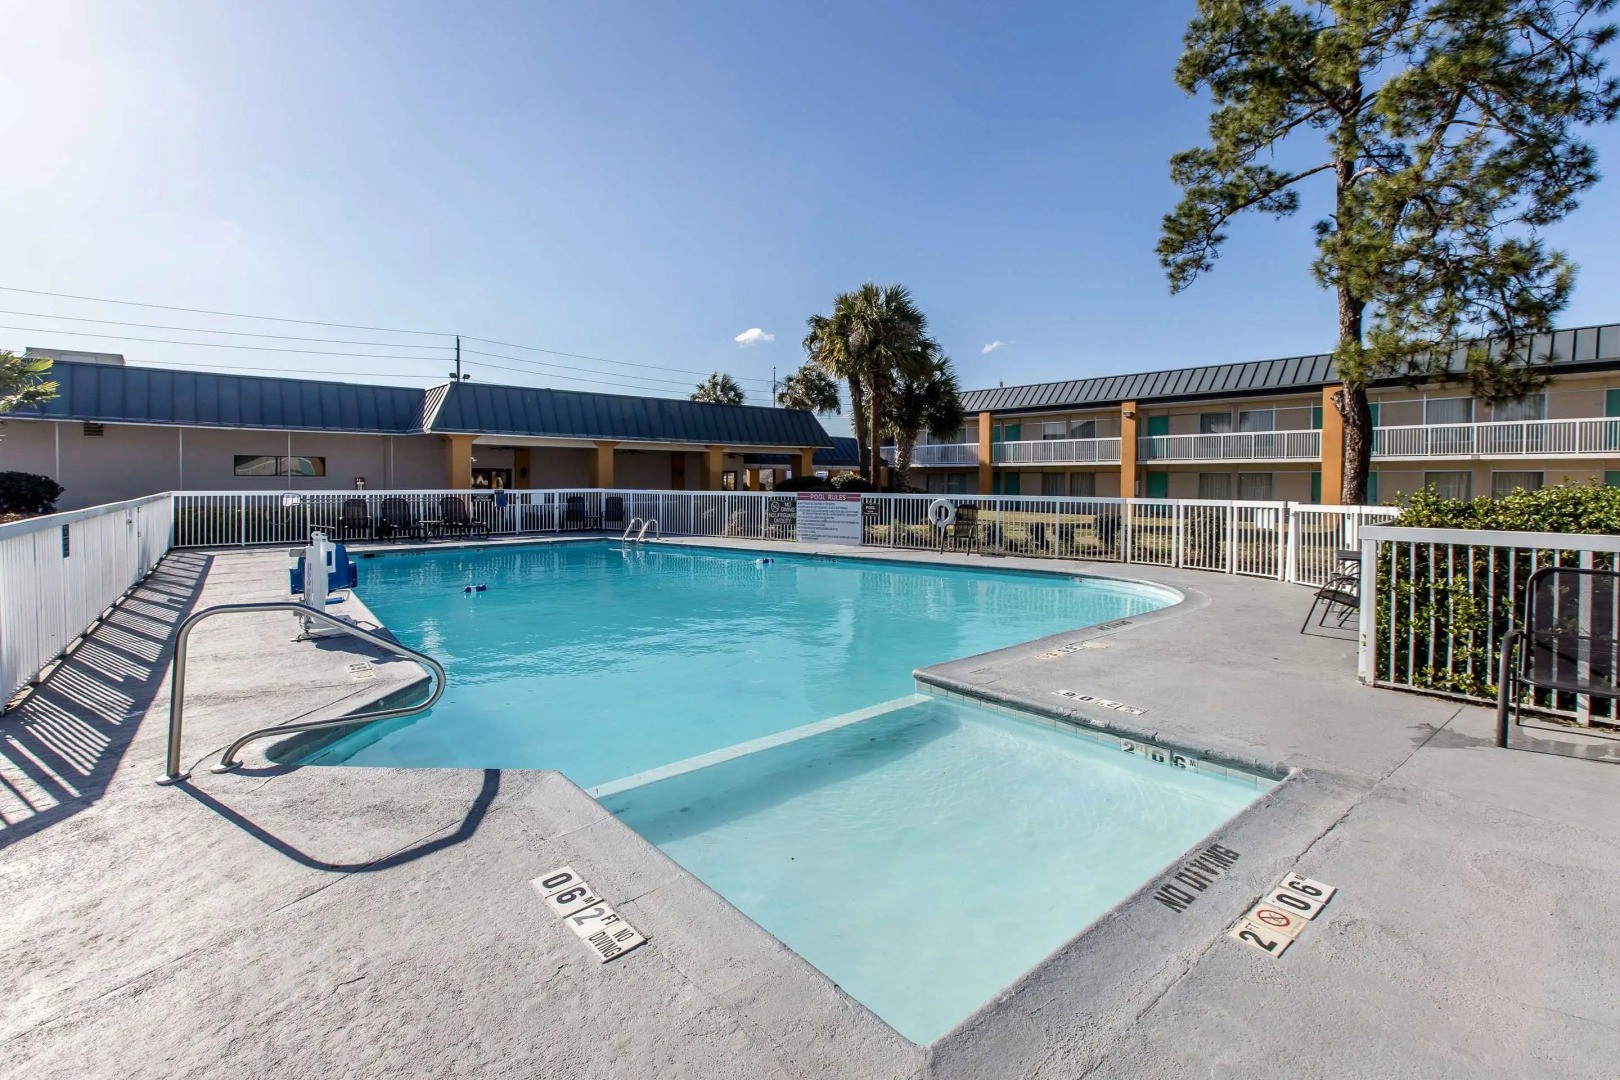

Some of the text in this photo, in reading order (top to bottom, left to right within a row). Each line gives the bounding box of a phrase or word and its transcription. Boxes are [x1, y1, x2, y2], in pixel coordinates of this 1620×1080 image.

[1123, 741, 1135, 755] 2
[1152, 843, 1240, 914] NO DIVING
[572, 907, 605, 927] 2
[588, 931, 622, 959] DIVING
[612, 928, 635, 943] NO
[1238, 930, 1279, 952] 2
